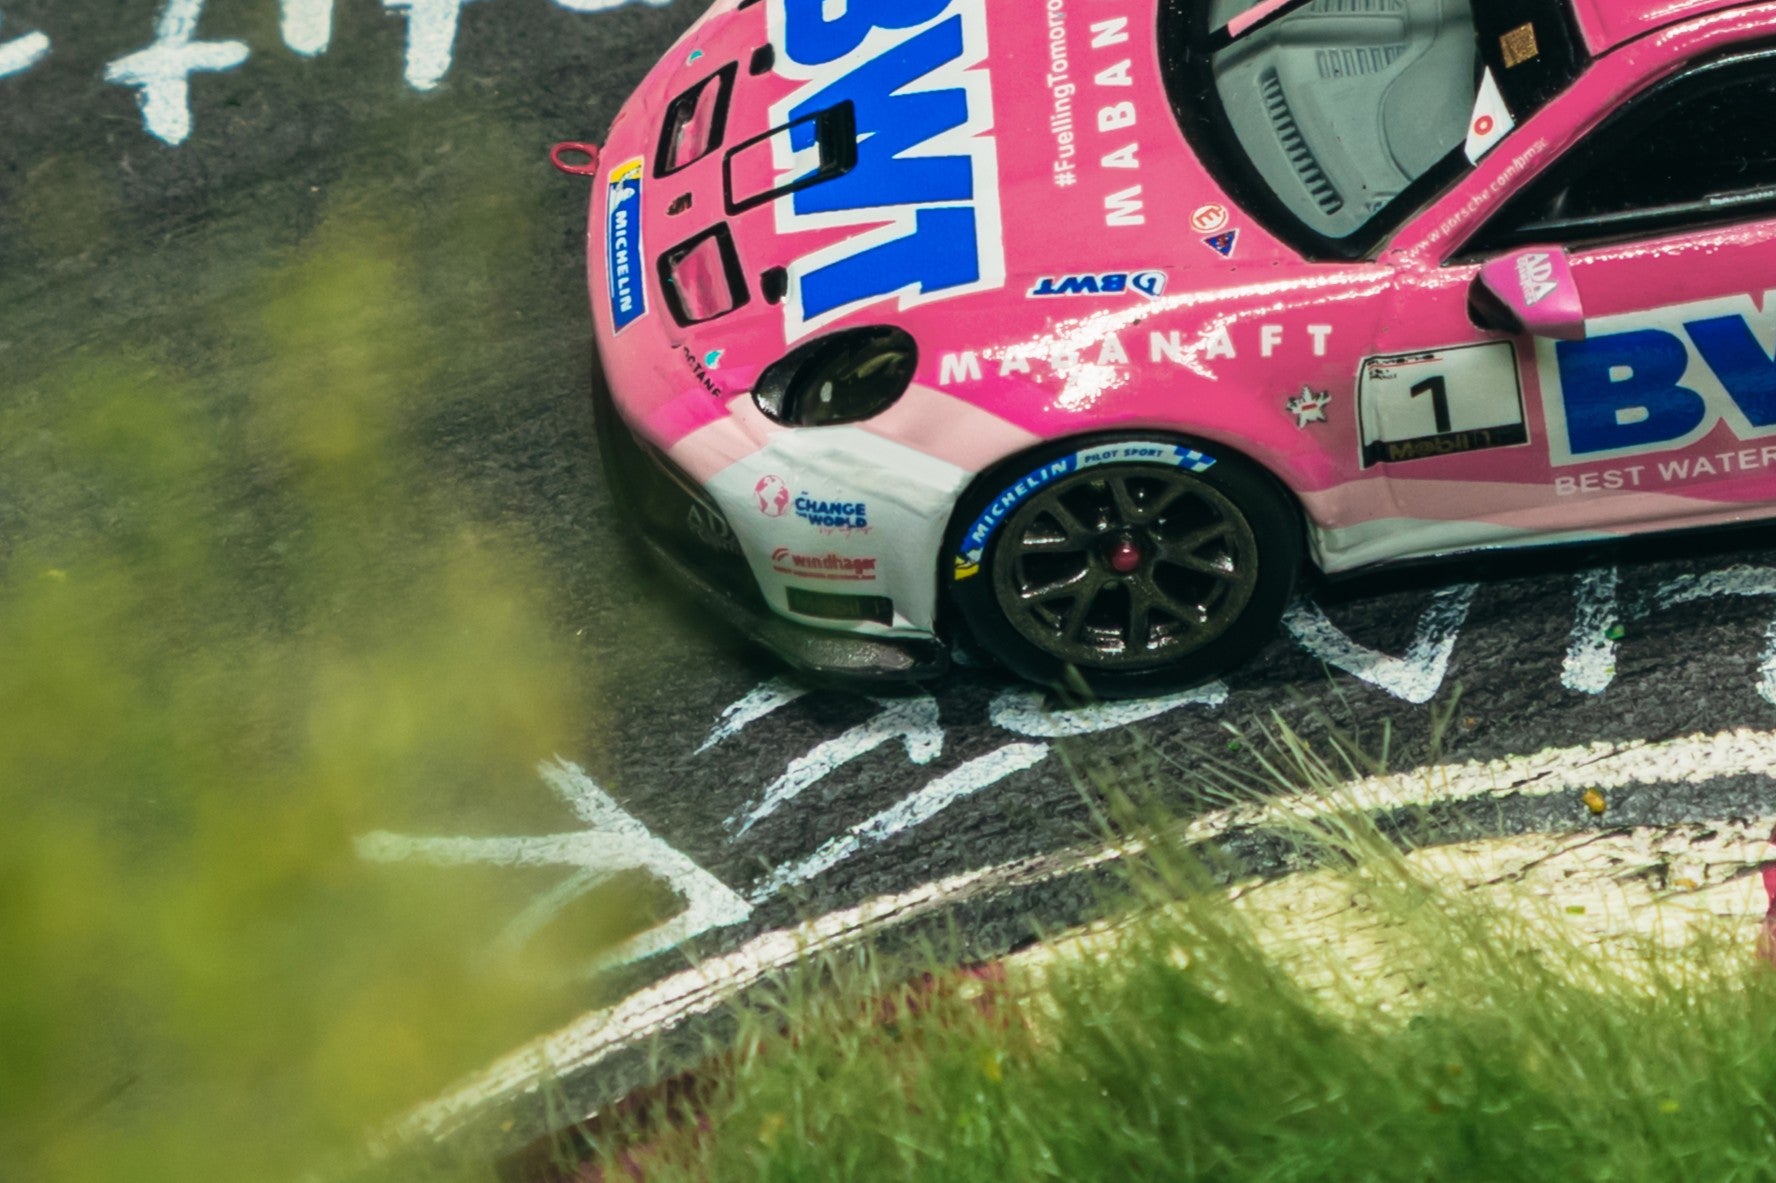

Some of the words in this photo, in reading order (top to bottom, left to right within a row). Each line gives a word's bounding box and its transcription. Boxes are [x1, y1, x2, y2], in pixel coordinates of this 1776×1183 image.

[614, 208, 632, 314] MICHELIN
[1034, 274, 1126, 296] BWT
[1526, 254, 1557, 304] ADA
[939, 323, 1332, 384] MABANAFT
[1409, 374, 1450, 433] 1
[1085, 449, 1118, 464] PILOT
[1123, 448, 1164, 458] SPORT
[1554, 465, 1642, 497] BEST
[795, 497, 866, 516] CHANGE
[972, 460, 1067, 543] MICHELIN
[808, 513, 867, 528] WORLD
[793, 553, 876, 575] windhager
